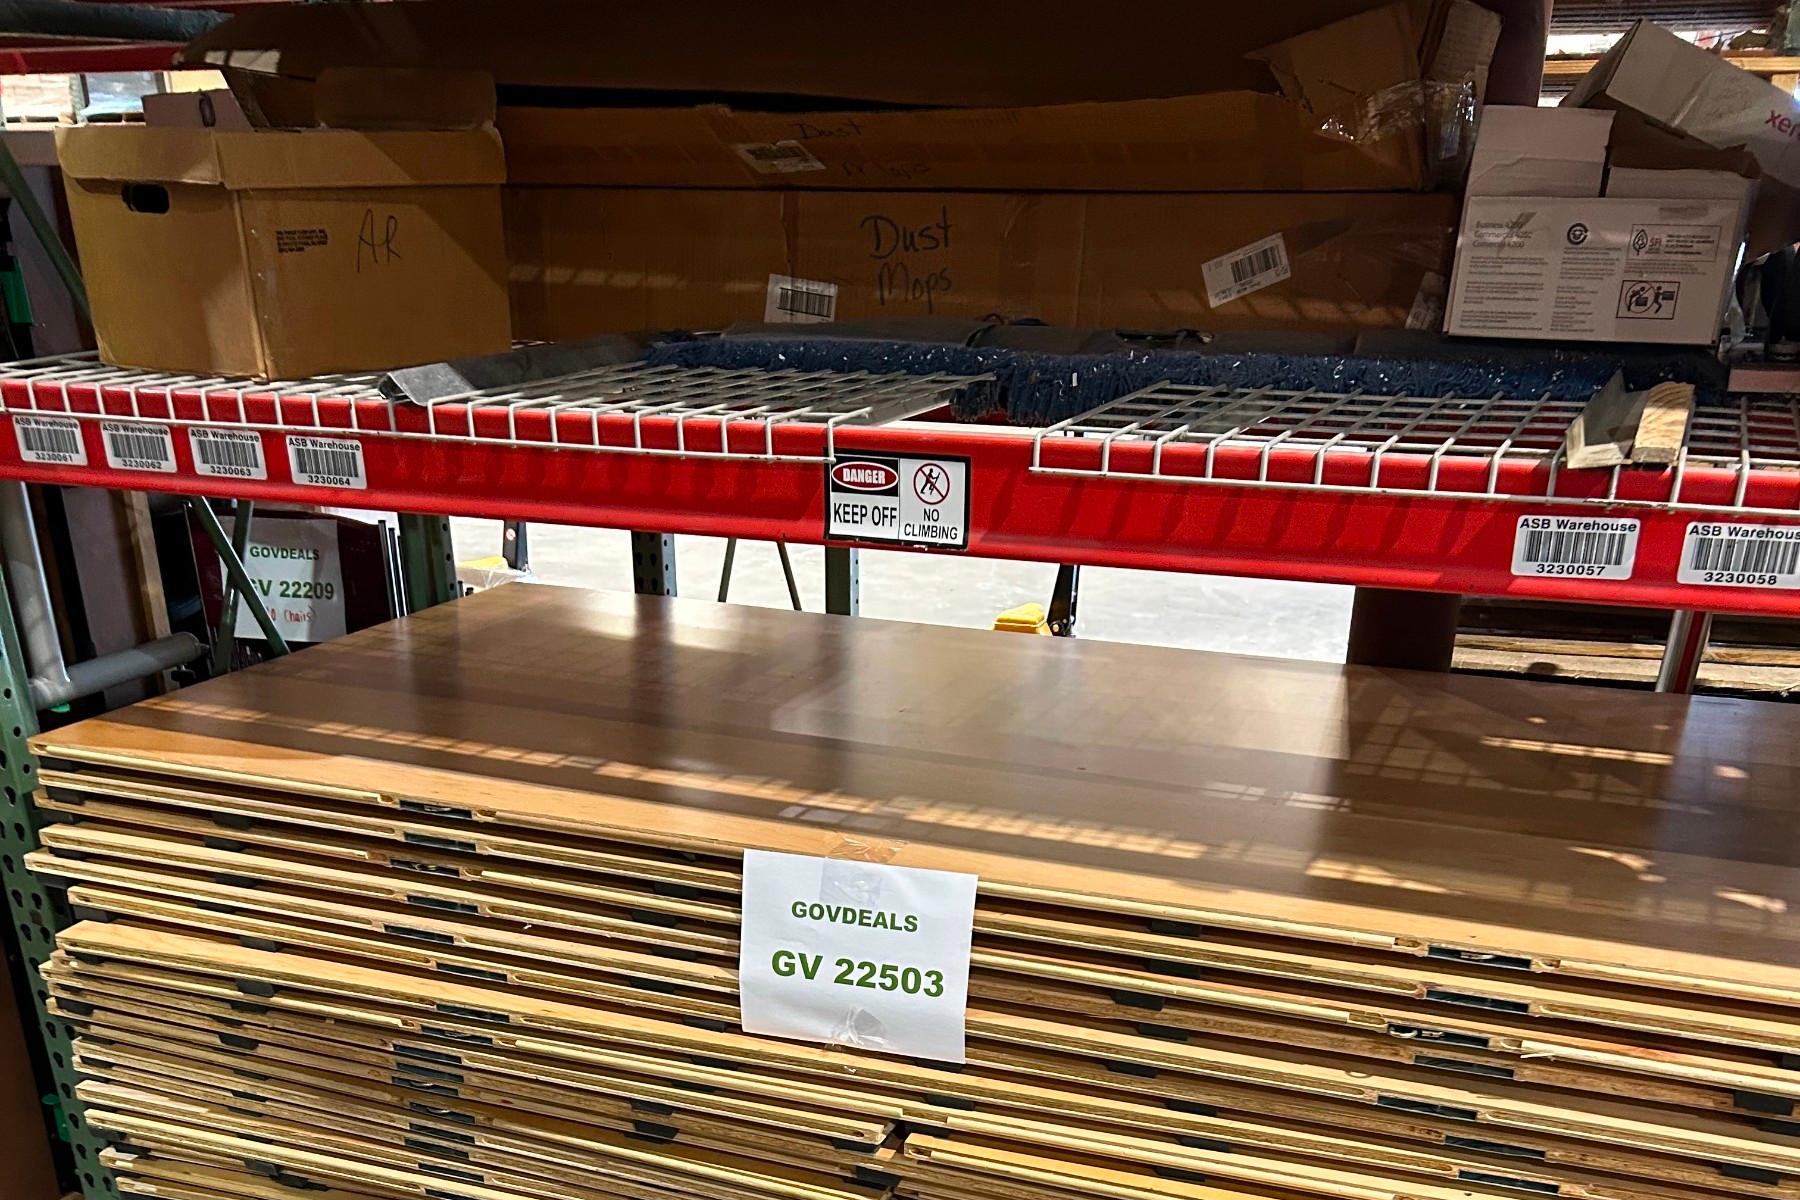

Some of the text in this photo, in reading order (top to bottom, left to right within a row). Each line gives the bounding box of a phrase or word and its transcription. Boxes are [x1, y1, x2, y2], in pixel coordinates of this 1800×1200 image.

[796, 118, 863, 139] Dust
[860, 205, 952, 259] Dust
[878, 261, 952, 315] Mops
[15, 416, 79, 430] ASB Warehouse
[103, 423, 169, 436] ASB Warehouse
[190, 429, 260, 443] ASB Warehouse
[288, 437, 360, 451] ASB Warehouse
[35, 452, 73, 463] 3230061
[122, 459, 162, 470] 3230062
[210, 465, 252, 477] 3230063
[842, 467, 886, 485] DANGER
[308, 475, 351, 486] 3230064
[833, 502, 898, 527] KEEP OFF
[923, 507, 940, 522] NO
[904, 522, 958, 540] CLIMBING
[1519, 518, 1637, 533] ASB Warehouse
[1688, 525, 1800, 540] ASB Warehous
[250, 546, 320, 561] GOVDEALS
[1536, 563, 1606, 577] 3230057
[1703, 571, 1777, 586] 3230058
[279, 580, 334, 600] 22209
[791, 901, 919, 933] GOVDEALS
[771, 950, 945, 998] GV 22503
